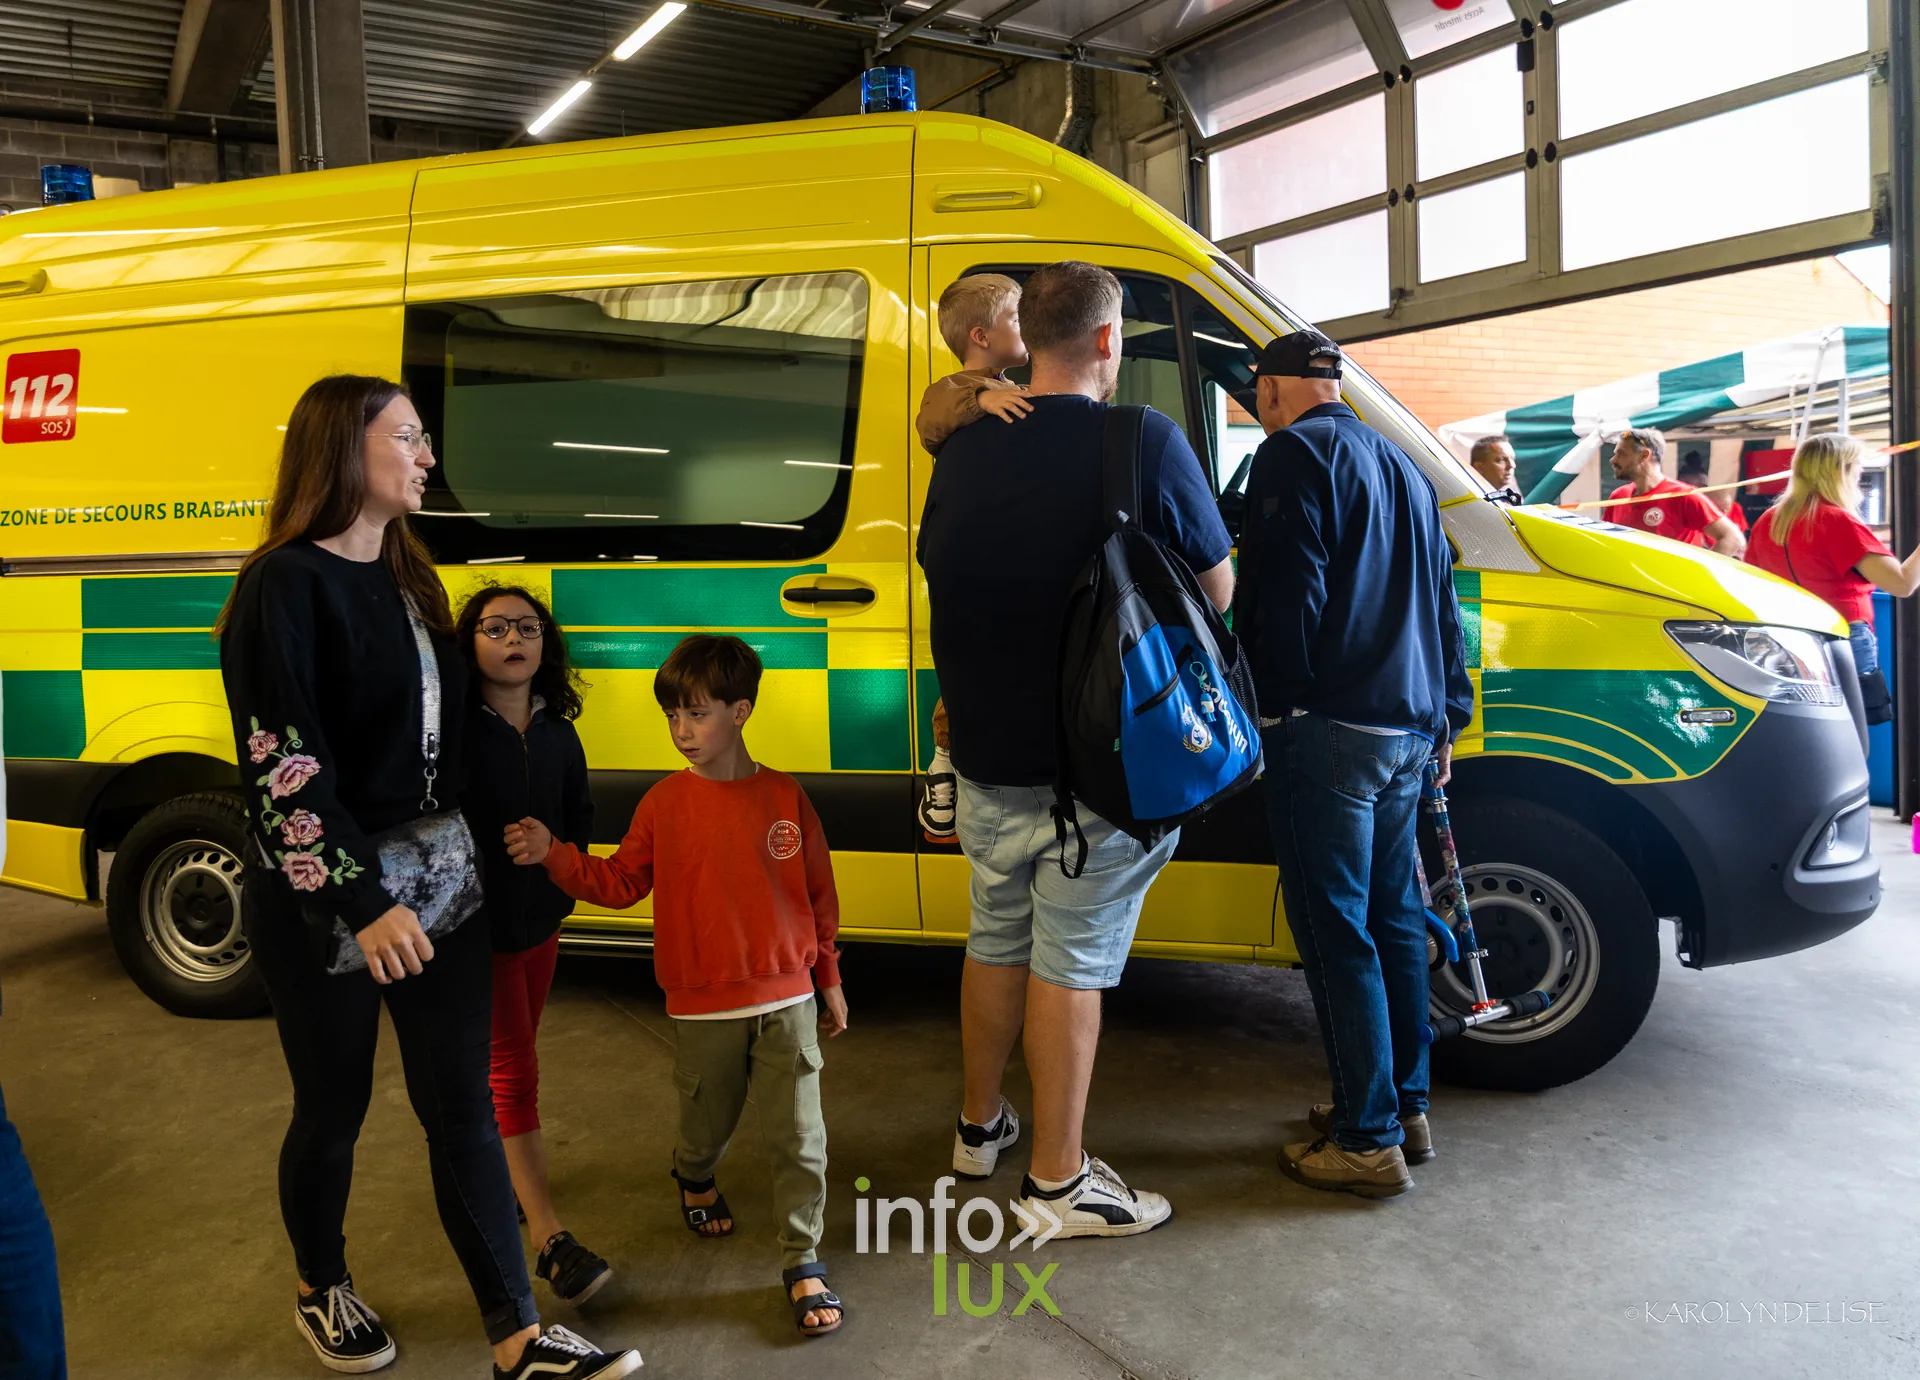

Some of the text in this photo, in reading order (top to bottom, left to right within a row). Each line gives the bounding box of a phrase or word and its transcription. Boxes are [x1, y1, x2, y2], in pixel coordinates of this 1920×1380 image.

[9, 373, 74, 420] 112
[41, 421, 63, 434] SOS
[0, 499, 268, 526] ZONE DE SECOURS BRABANT
